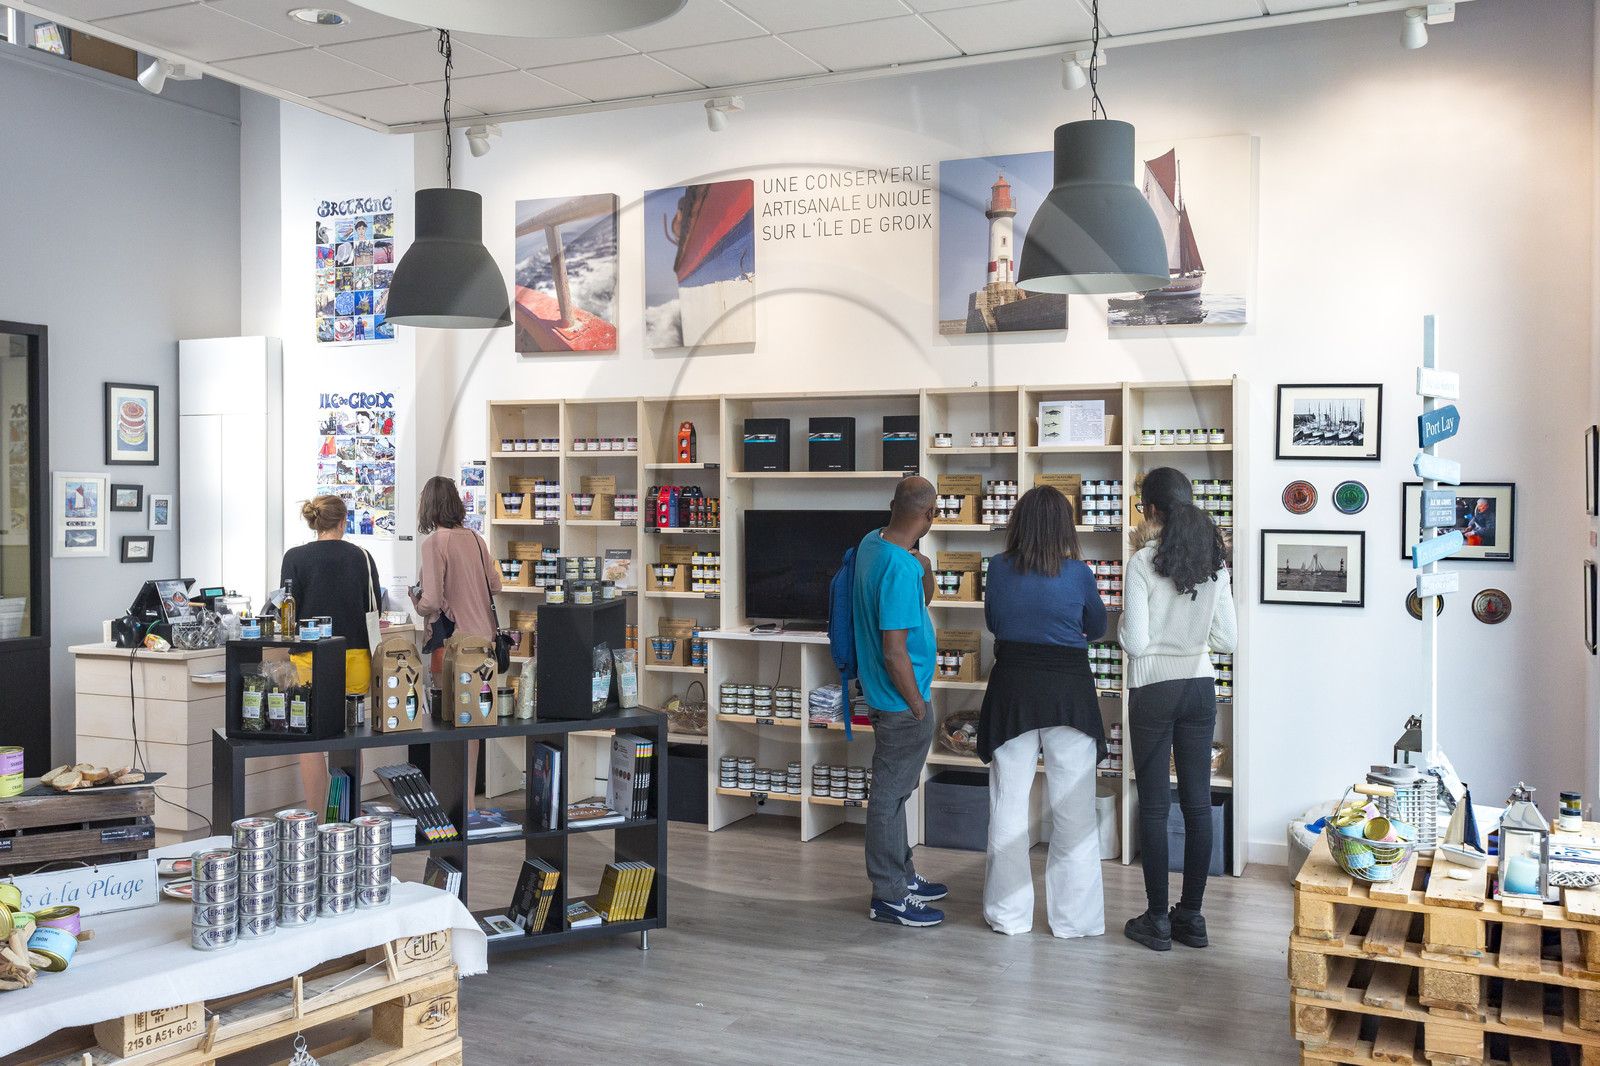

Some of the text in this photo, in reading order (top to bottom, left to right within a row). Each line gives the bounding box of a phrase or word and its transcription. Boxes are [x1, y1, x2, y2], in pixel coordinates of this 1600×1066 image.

[763, 164, 932, 194] UNE CONSERVERIE
[317, 196, 393, 218] BRETAGNE
[762, 188, 932, 218] ARTISANALE UNIQUE
[762, 213, 932, 241] SUR L'ÎLE DE GROIX
[349, 391, 395, 410] GROIX
[1426, 416, 1454, 438] Port Lay
[253, 852, 268, 860] MARIN
[208, 862, 214, 872] LE
[215, 862, 226, 871] PATE
[40, 887, 52, 906] à
[61, 881, 79, 903] la
[86, 875, 144, 900] Plage
[211, 885, 216, 893] LE
[217, 884, 228, 893] PATE
[208, 908, 214, 916] LE
[215, 907, 225, 916] PATE
[207, 930, 213, 938] LE
[413, 932, 438, 956] EUR
[155, 1014, 164, 1023] HT
